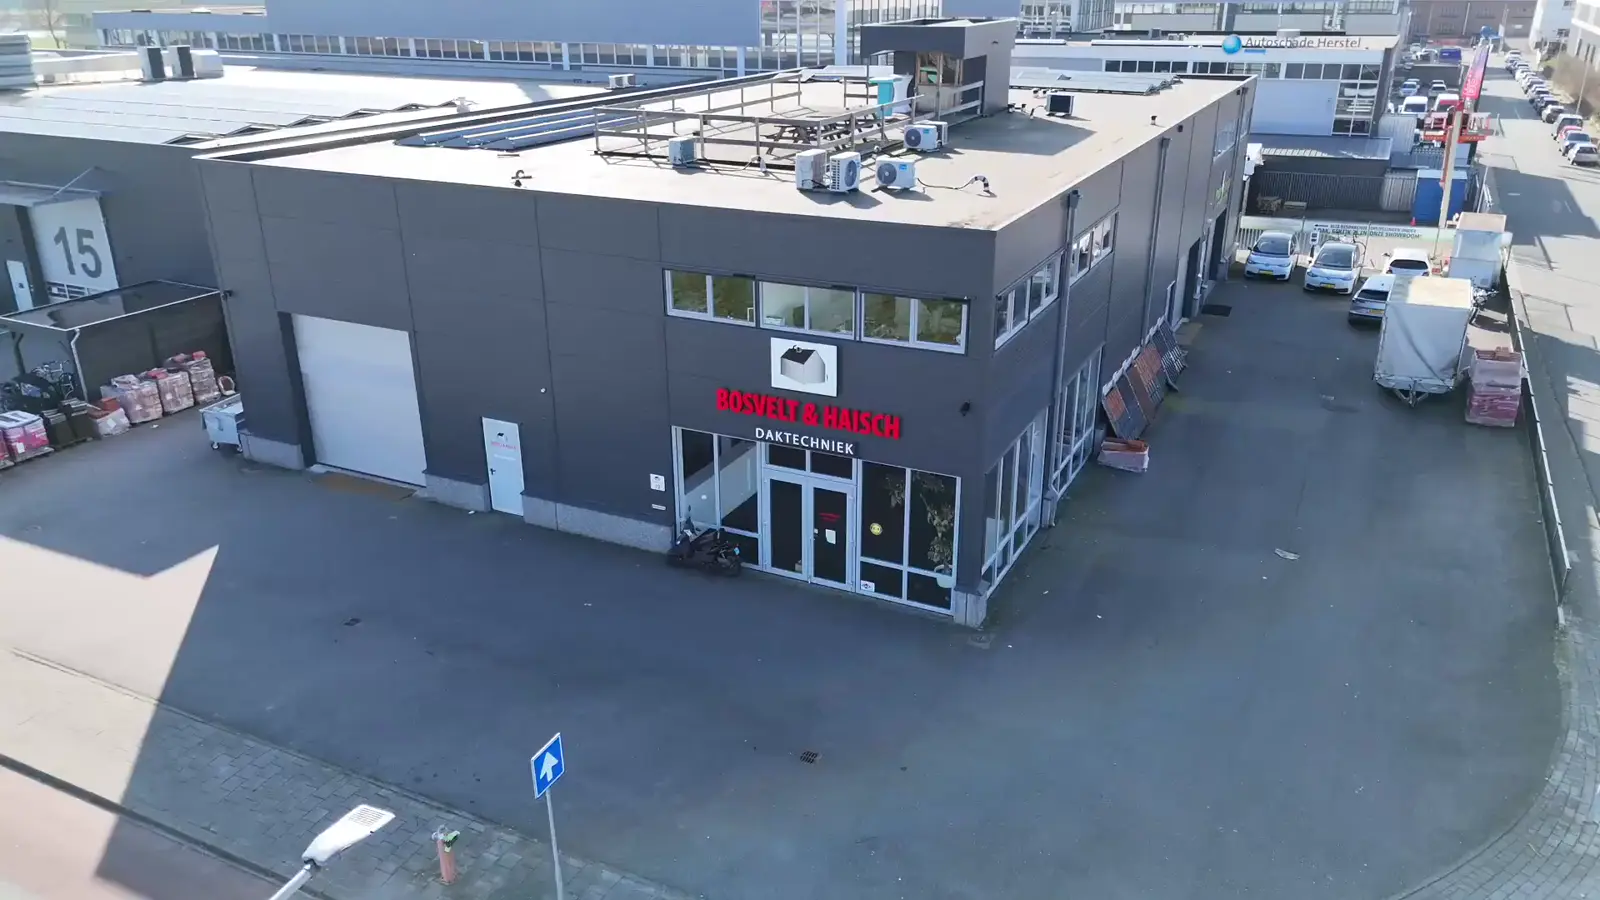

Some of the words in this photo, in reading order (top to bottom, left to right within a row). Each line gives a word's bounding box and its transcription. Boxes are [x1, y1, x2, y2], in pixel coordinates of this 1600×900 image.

[1246, 36, 1314, 48] Autoschade
[1317, 37, 1361, 48] Herstel
[54, 226, 102, 278] 15
[716, 387, 800, 423] BOSVELT
[802, 402, 819, 427] &
[823, 405, 901, 440] HAISCH
[755, 427, 854, 455] DAKTECHNIEK
